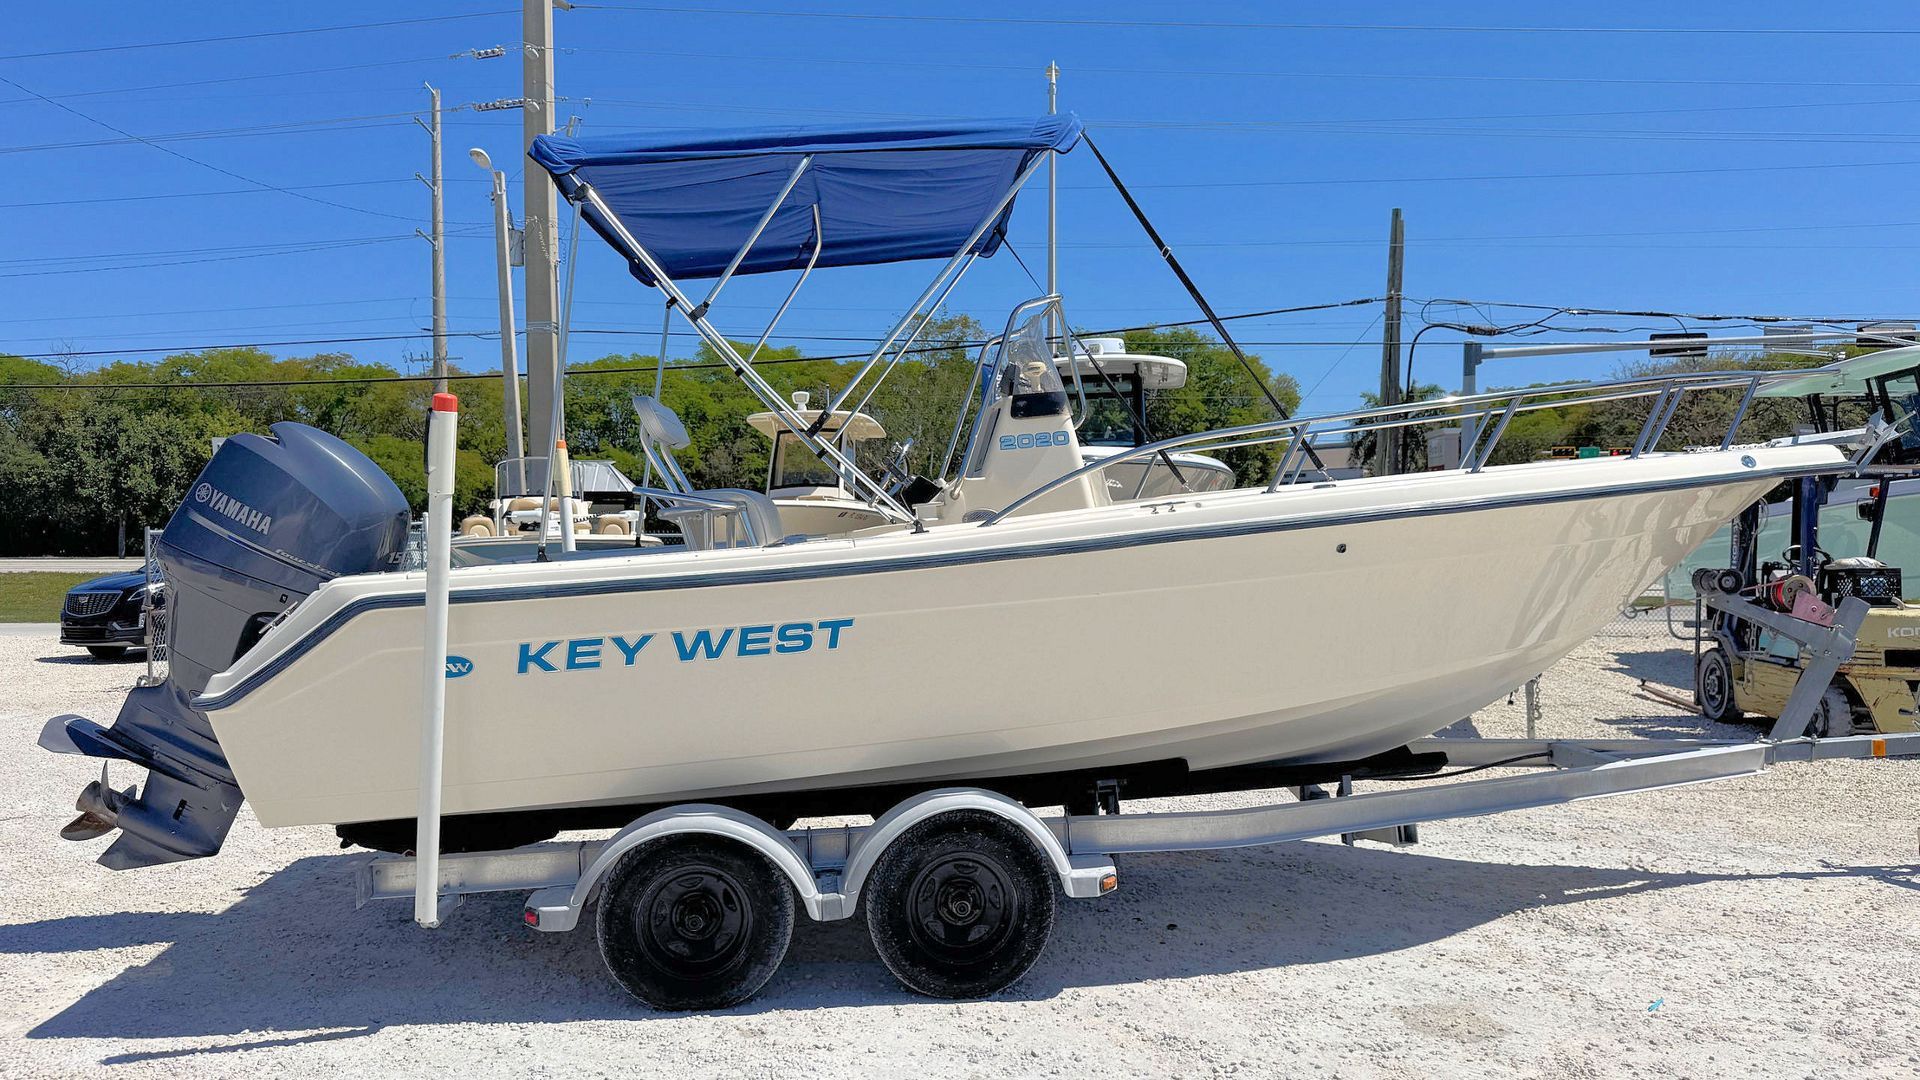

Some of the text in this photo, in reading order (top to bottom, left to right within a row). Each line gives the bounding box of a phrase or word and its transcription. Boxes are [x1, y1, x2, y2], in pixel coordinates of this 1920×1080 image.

[999, 430, 1069, 450] 2020
[209, 487, 272, 535] YAMAHA
[517, 617, 856, 675] KEY WEST
[446, 662, 470, 673] W
